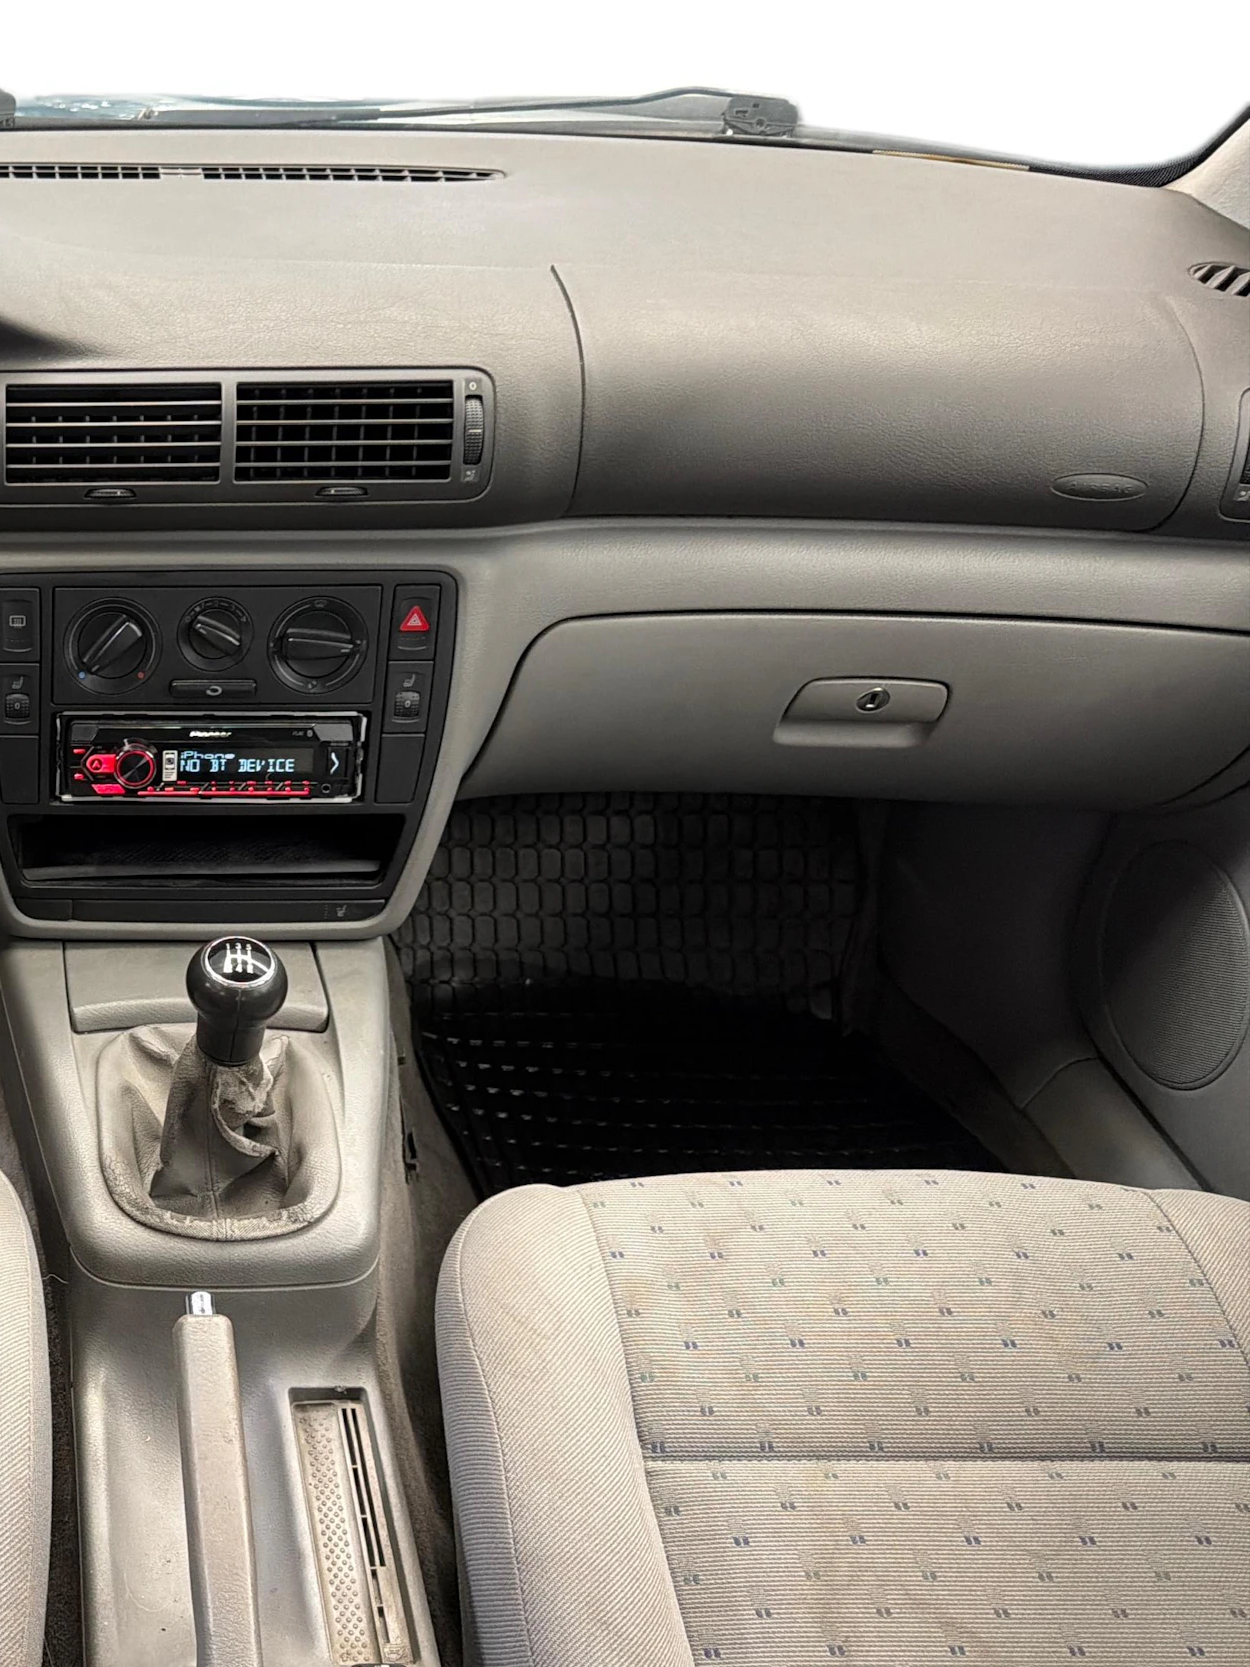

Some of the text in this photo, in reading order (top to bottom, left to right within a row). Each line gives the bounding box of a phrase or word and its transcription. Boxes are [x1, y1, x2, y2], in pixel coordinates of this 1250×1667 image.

[180, 750, 236, 759] iPhone
[180, 759, 295, 772] NO BT DEVICE
